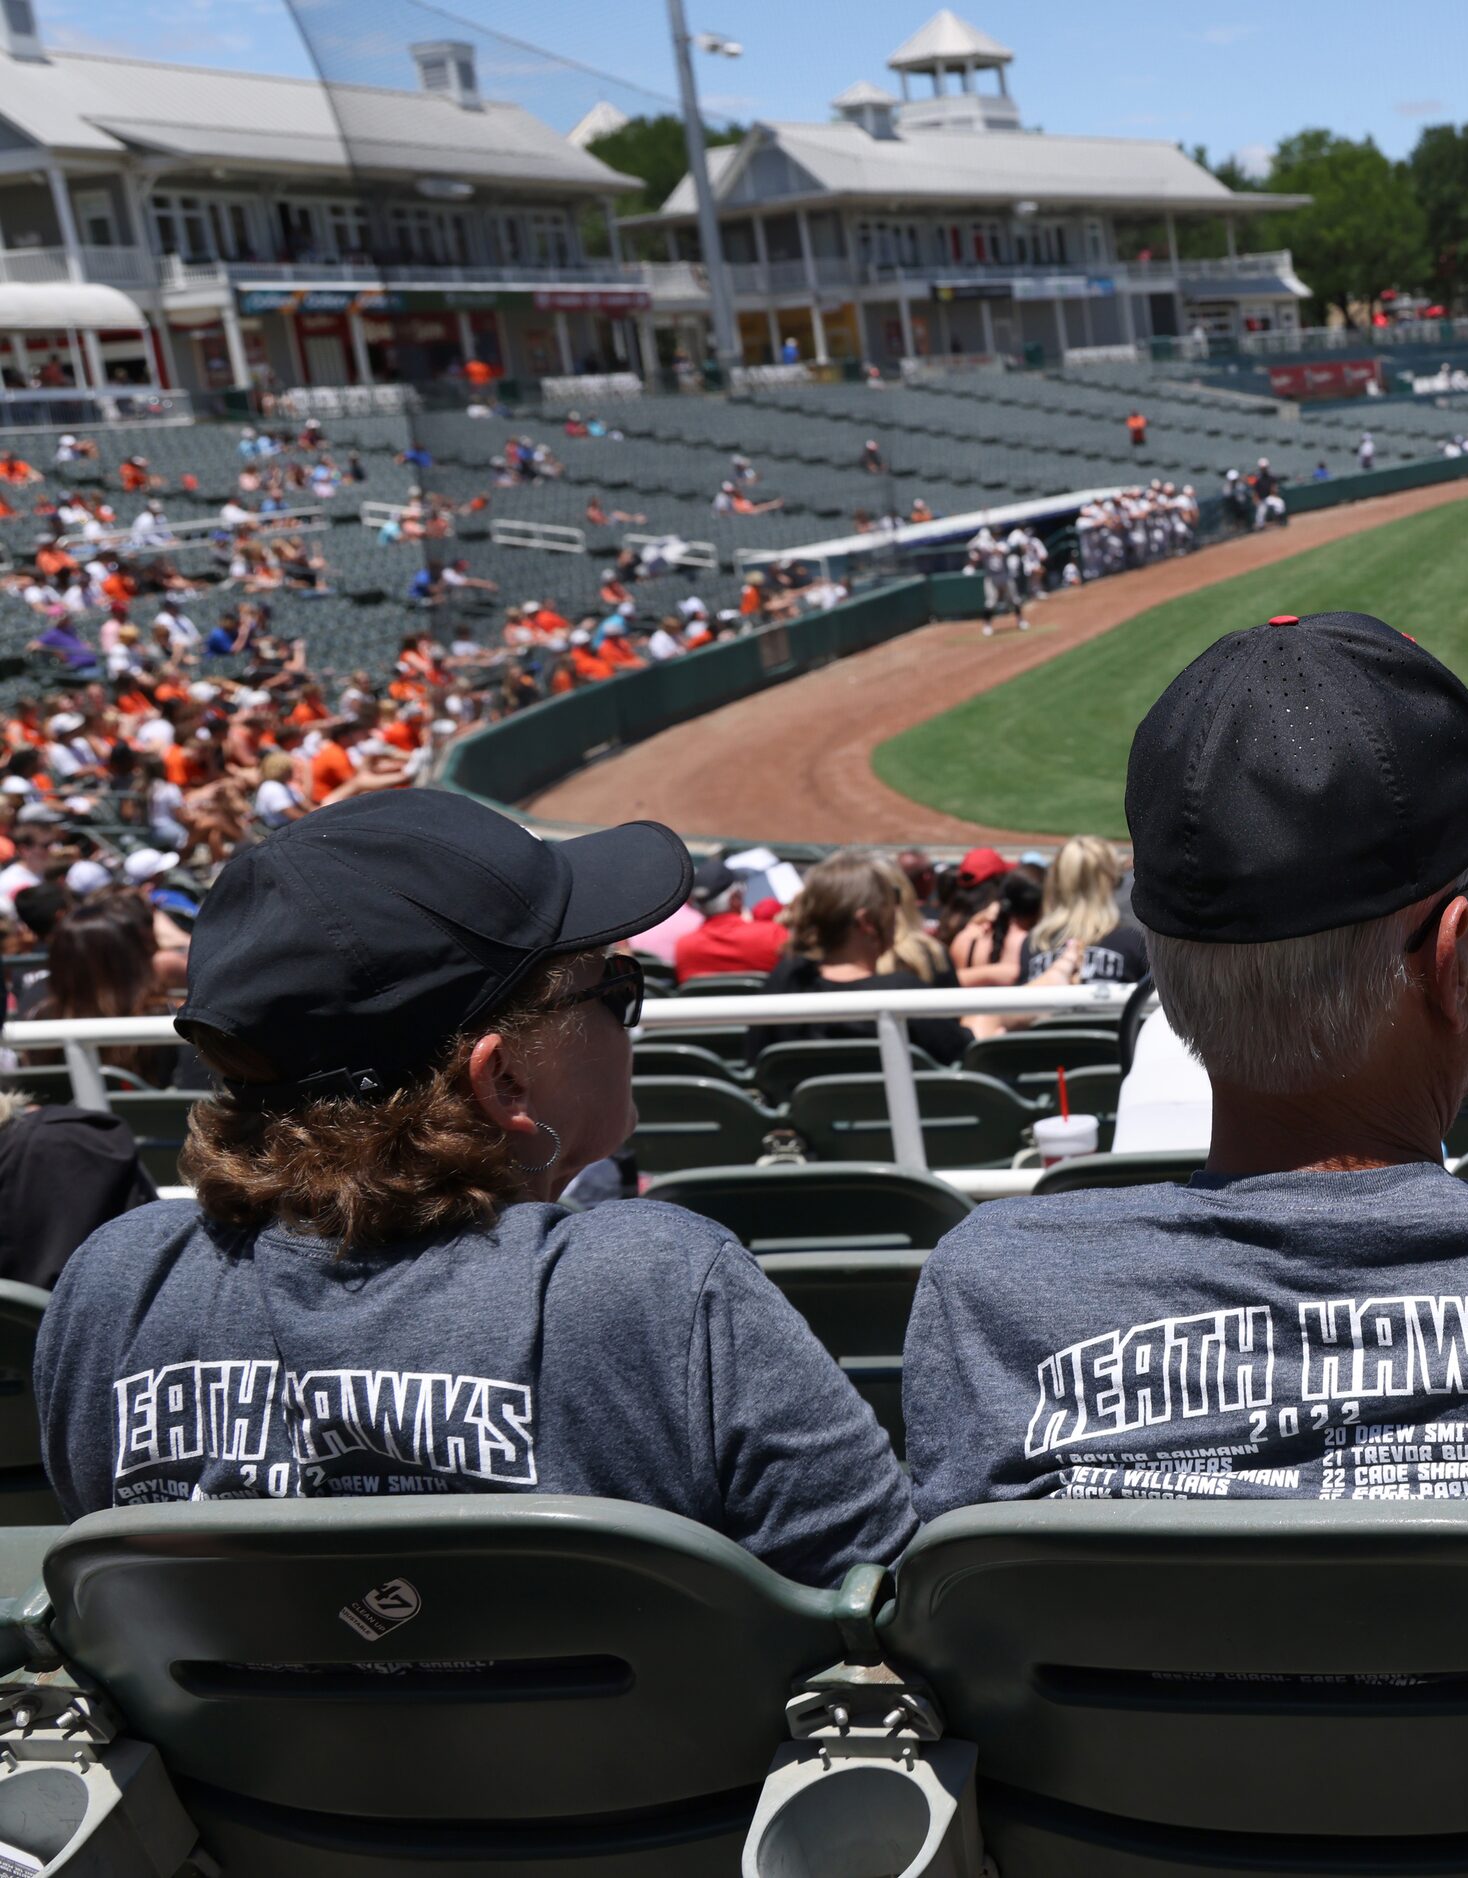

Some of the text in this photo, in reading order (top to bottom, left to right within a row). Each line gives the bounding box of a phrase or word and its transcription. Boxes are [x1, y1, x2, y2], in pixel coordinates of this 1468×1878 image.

[1025, 1305, 1273, 1459] HEATH
[1249, 1401, 1362, 1443] 2022
[1324, 1427, 1346, 1446] 20
[1355, 1424, 1415, 1444] DREW
[1322, 1449, 1342, 1467] 21
[1351, 1446, 1432, 1463] TREVOR
[330, 1476, 380, 1493] DREW
[388, 1475, 450, 1492] SMITH
[1123, 1470, 1231, 1495] WILLIAMS
[1322, 1468, 1346, 1488] 22
[1354, 1463, 1409, 1486] CADE
[117, 1479, 190, 1499] BAYLOR
[352, 1602, 387, 1632] CLEAN UP
